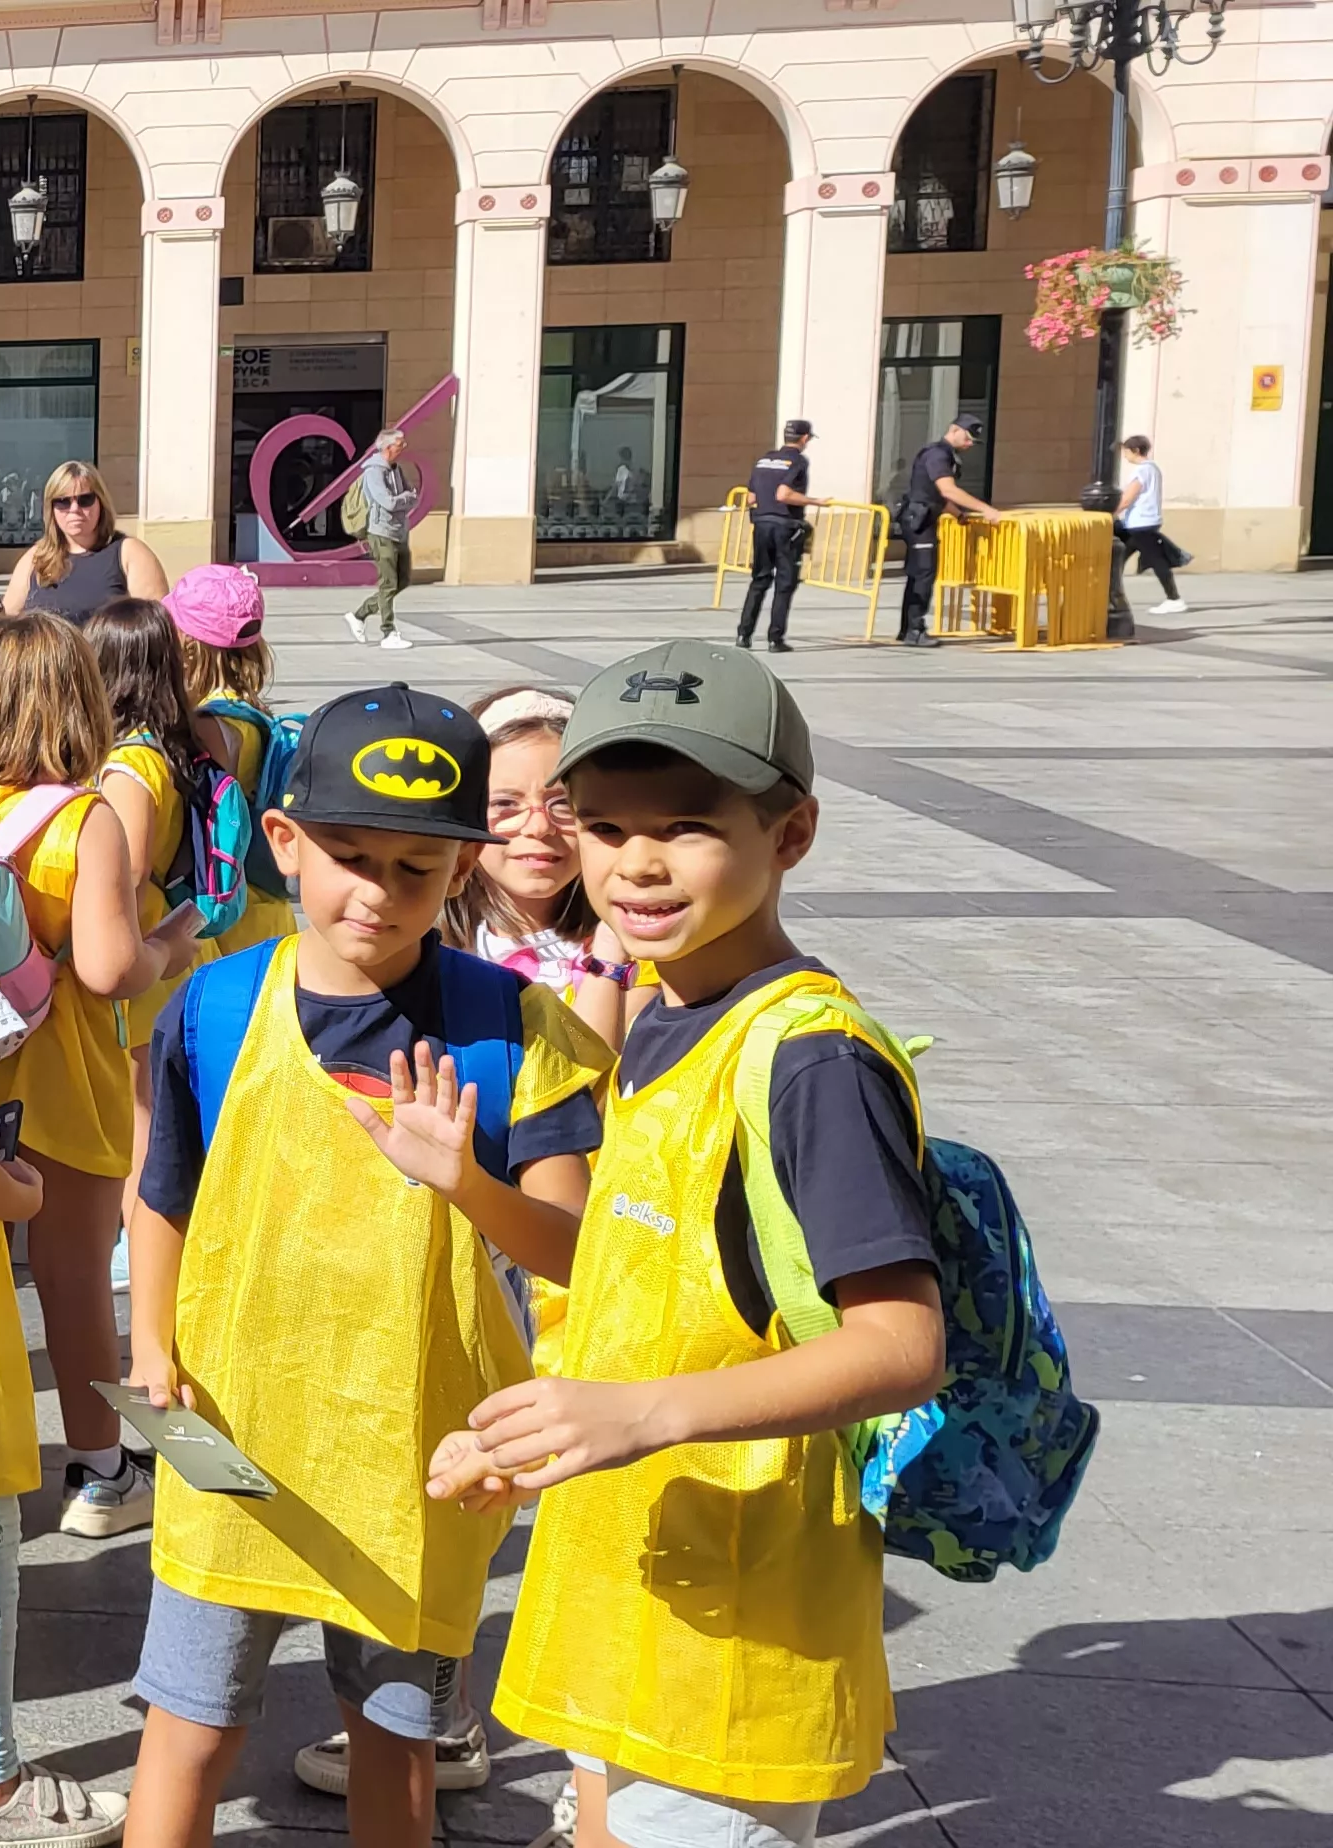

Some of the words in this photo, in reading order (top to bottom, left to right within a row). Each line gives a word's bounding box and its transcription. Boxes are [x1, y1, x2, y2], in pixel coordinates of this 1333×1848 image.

[234, 348, 271, 364] EOE
[234, 365, 270, 377] PYME
[629, 1203, 675, 1233] elksp
